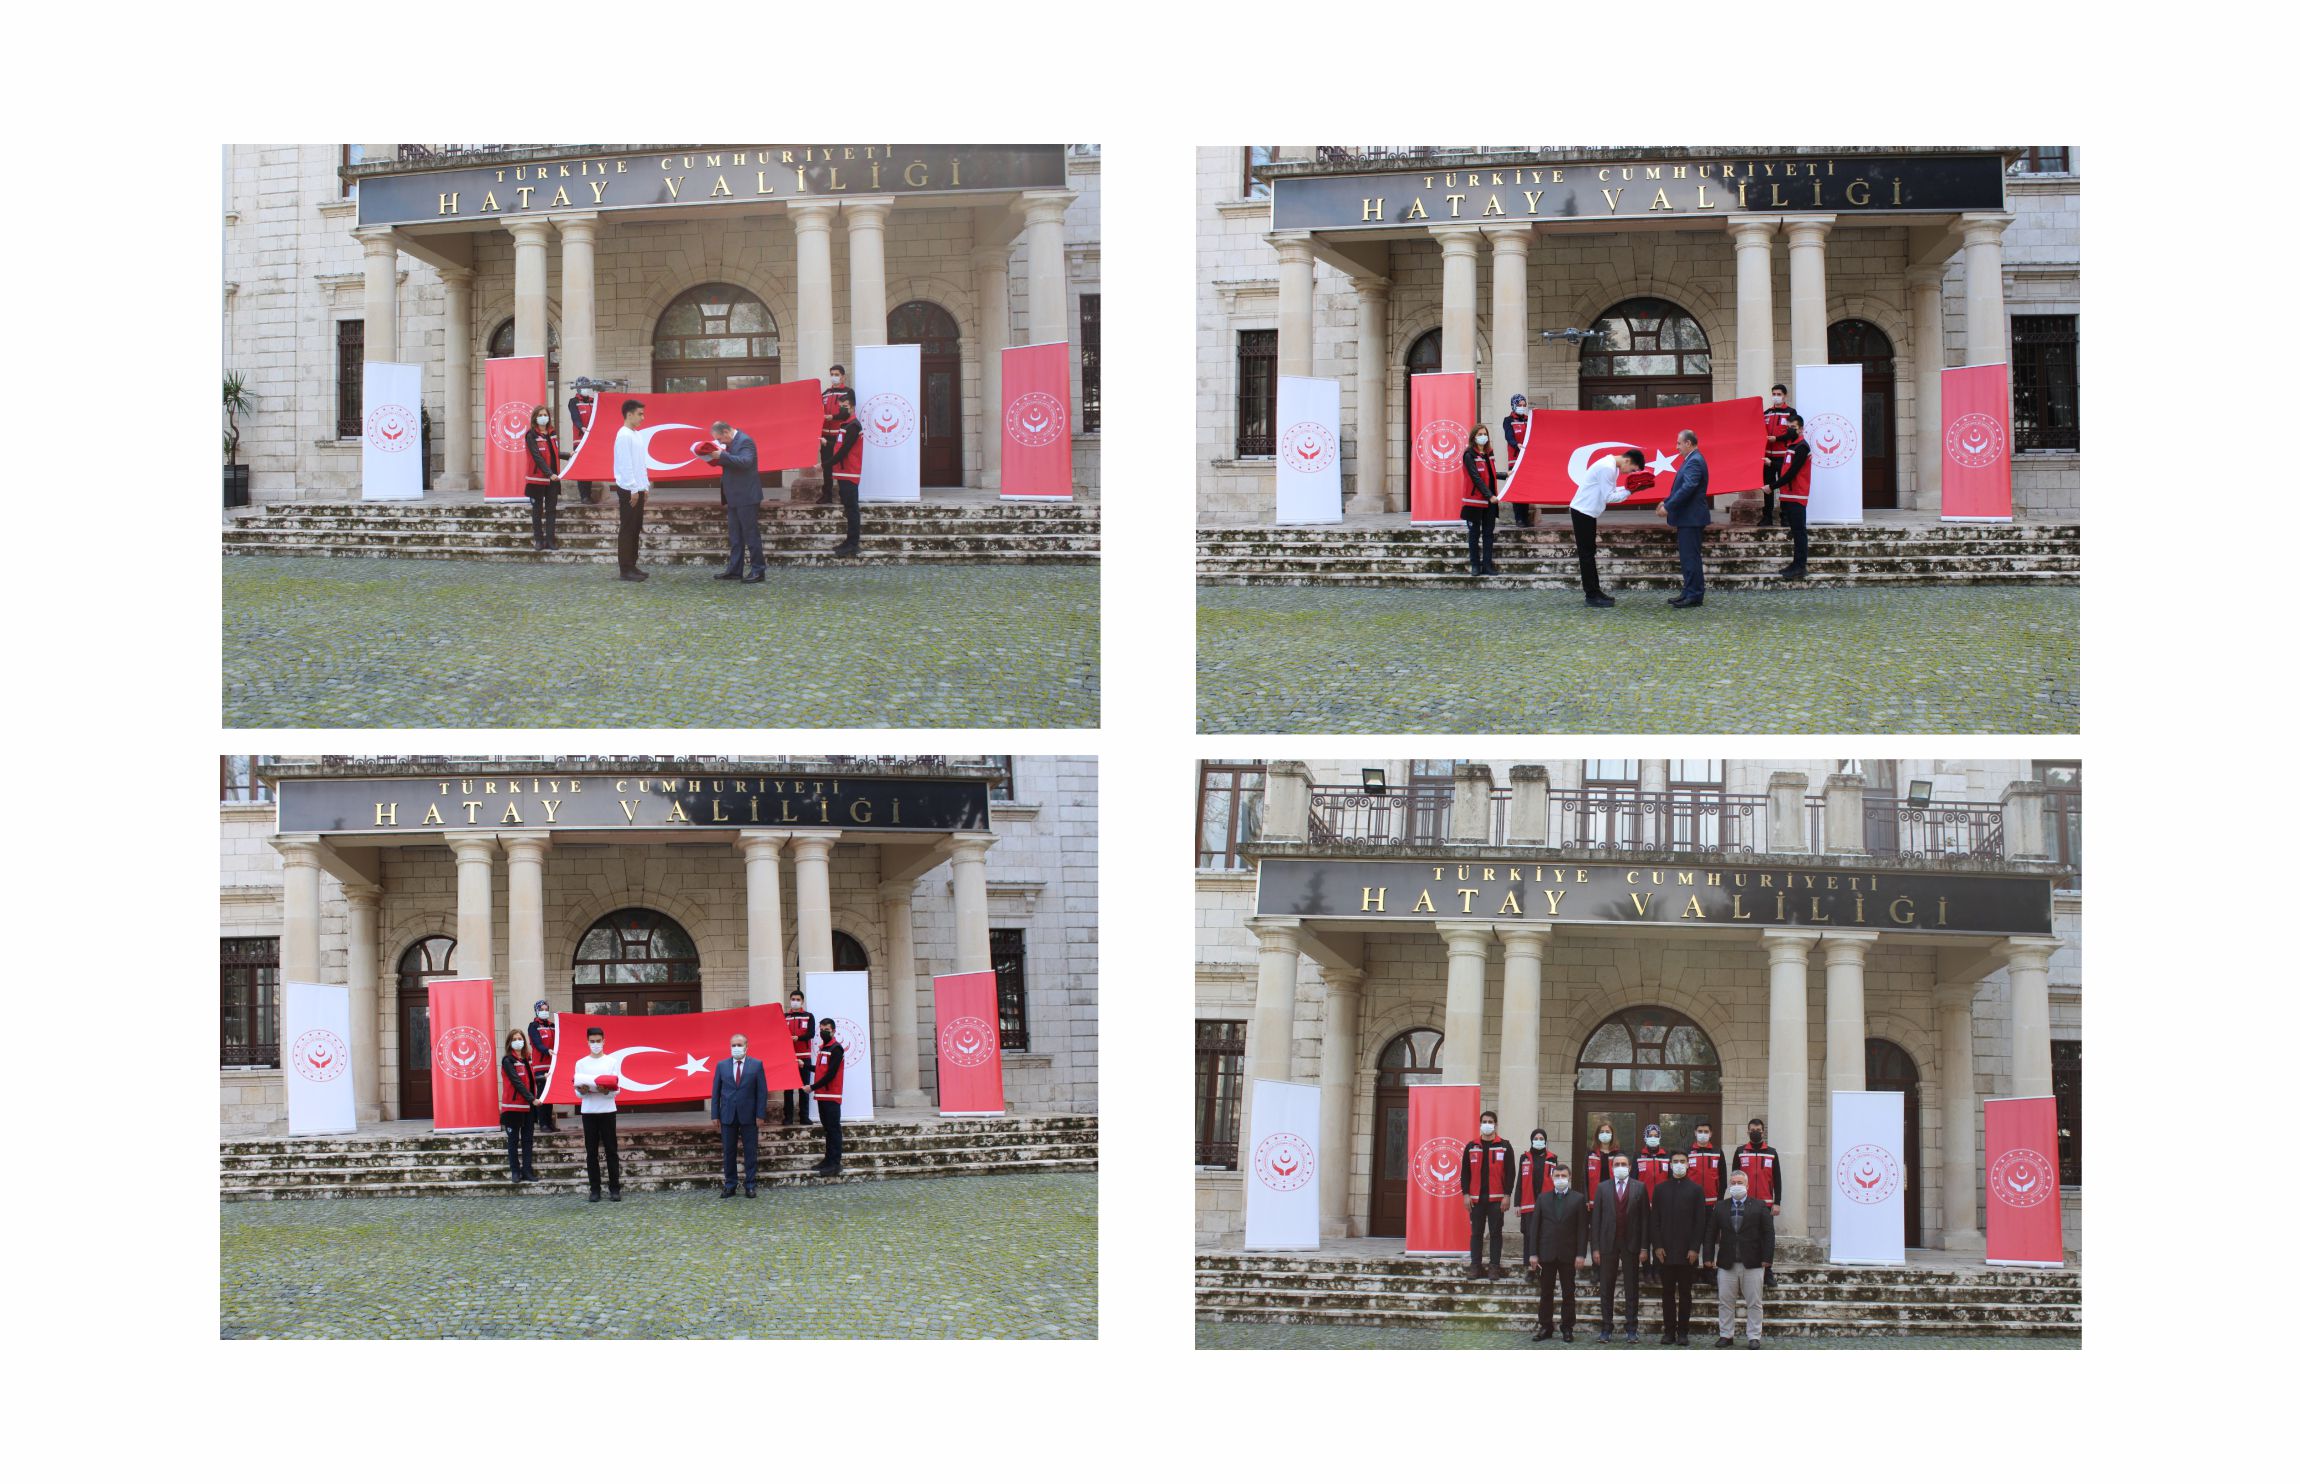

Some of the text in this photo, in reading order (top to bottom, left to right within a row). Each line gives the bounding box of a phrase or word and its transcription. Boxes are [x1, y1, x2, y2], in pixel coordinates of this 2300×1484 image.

[496, 144, 892, 182] TÜRKİYE CUMHURİYETİ
[1424, 160, 1835, 189] TÜRKİYE CUMHURİYETİ
[438, 158, 961, 215] HATAY VALİLİĞİ
[1361, 176, 1902, 221] HATAY VALİLİĞİ
[439, 778, 839, 795] TÜRKİYE CUMHURİYETİ
[374, 795, 901, 826] HATAY VALİLİĞİ
[1433, 865, 1878, 891] TÜRKİYE CUMHURİYETİ
[1360, 887, 1949, 925] HATAY VALİLİĞİ
